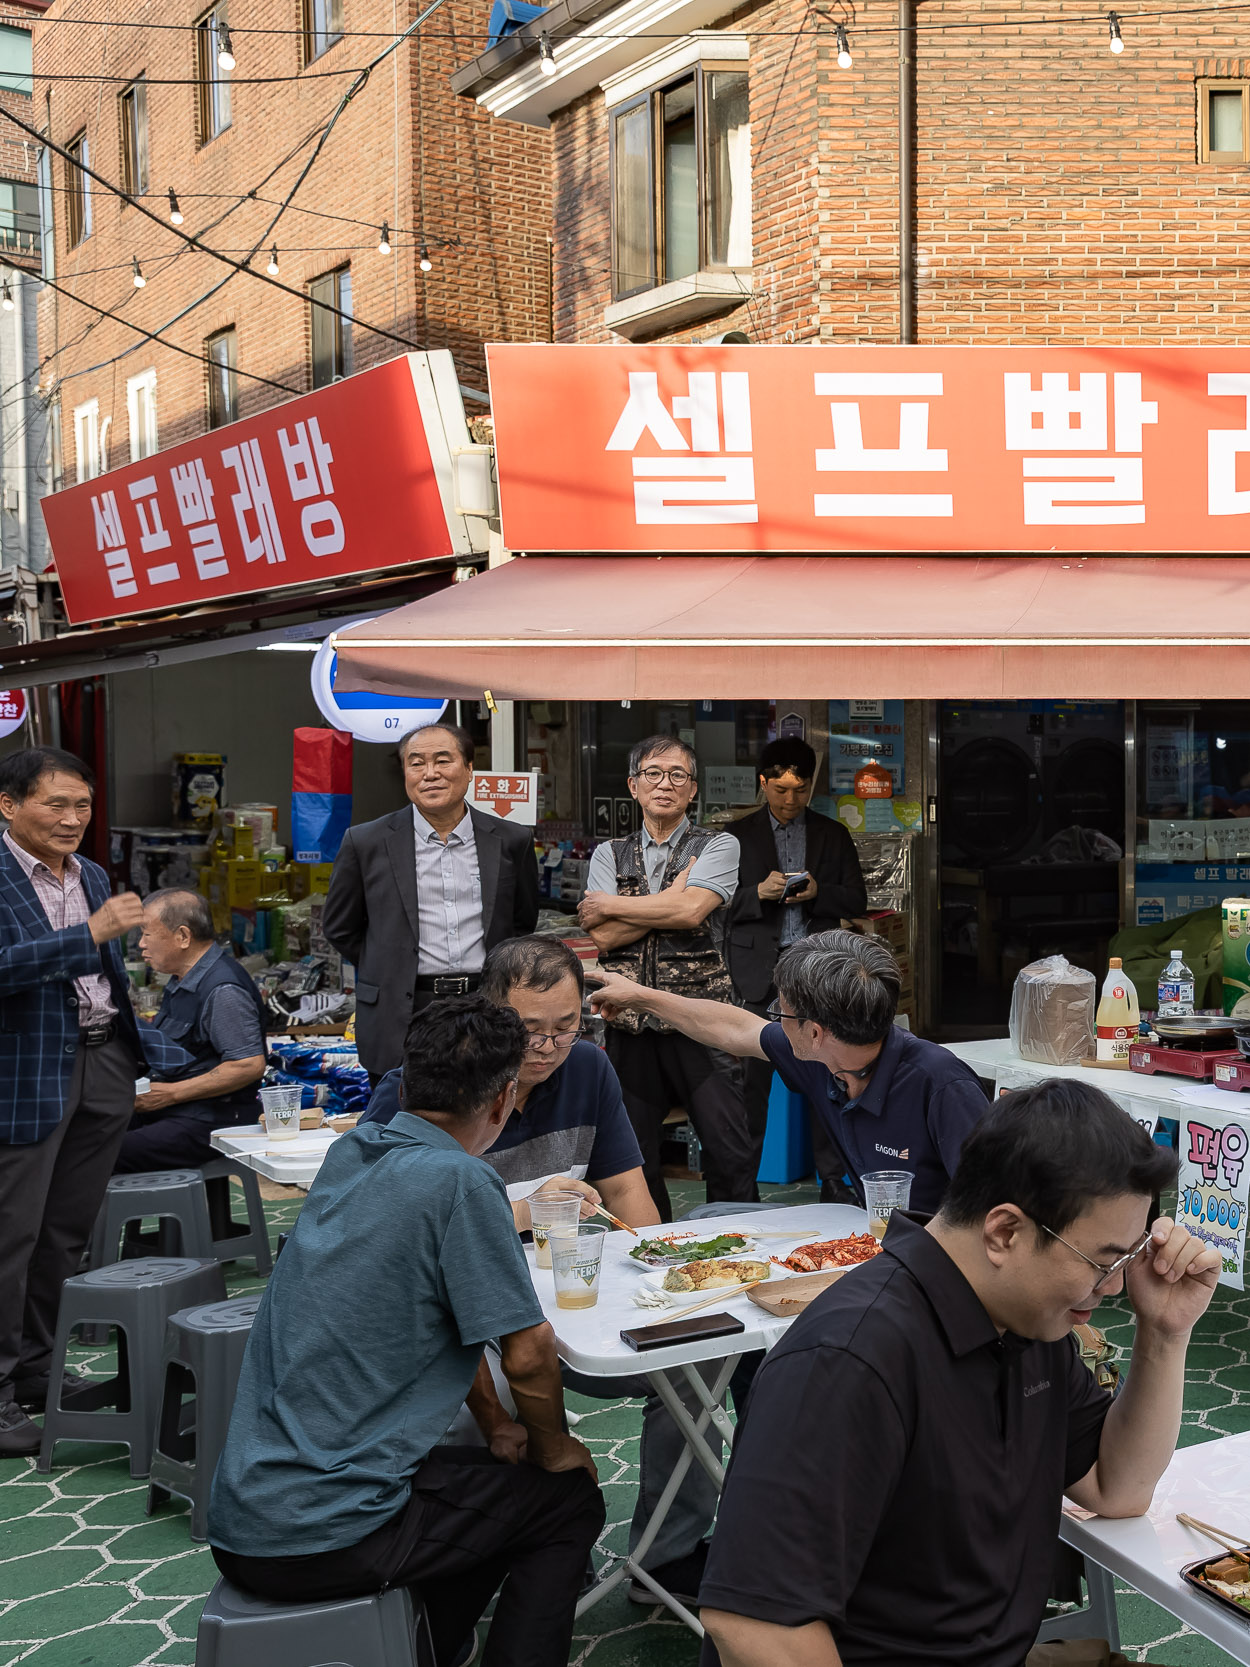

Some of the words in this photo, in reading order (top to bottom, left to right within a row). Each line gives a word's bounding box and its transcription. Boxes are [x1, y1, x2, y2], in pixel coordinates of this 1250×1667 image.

[91, 416, 345, 599] 셀프빨래방
[384, 718, 400, 729] 07
[840, 744, 870, 756] 가맹점
[873, 744, 894, 756] 모집
[476, 778, 528, 793] 소화기
[1194, 867, 1220, 881] 셀프
[272, 1109, 296, 1120] TERRA
[875, 1143, 899, 1158] EAGON
[1187, 1121, 1249, 1187] 편육
